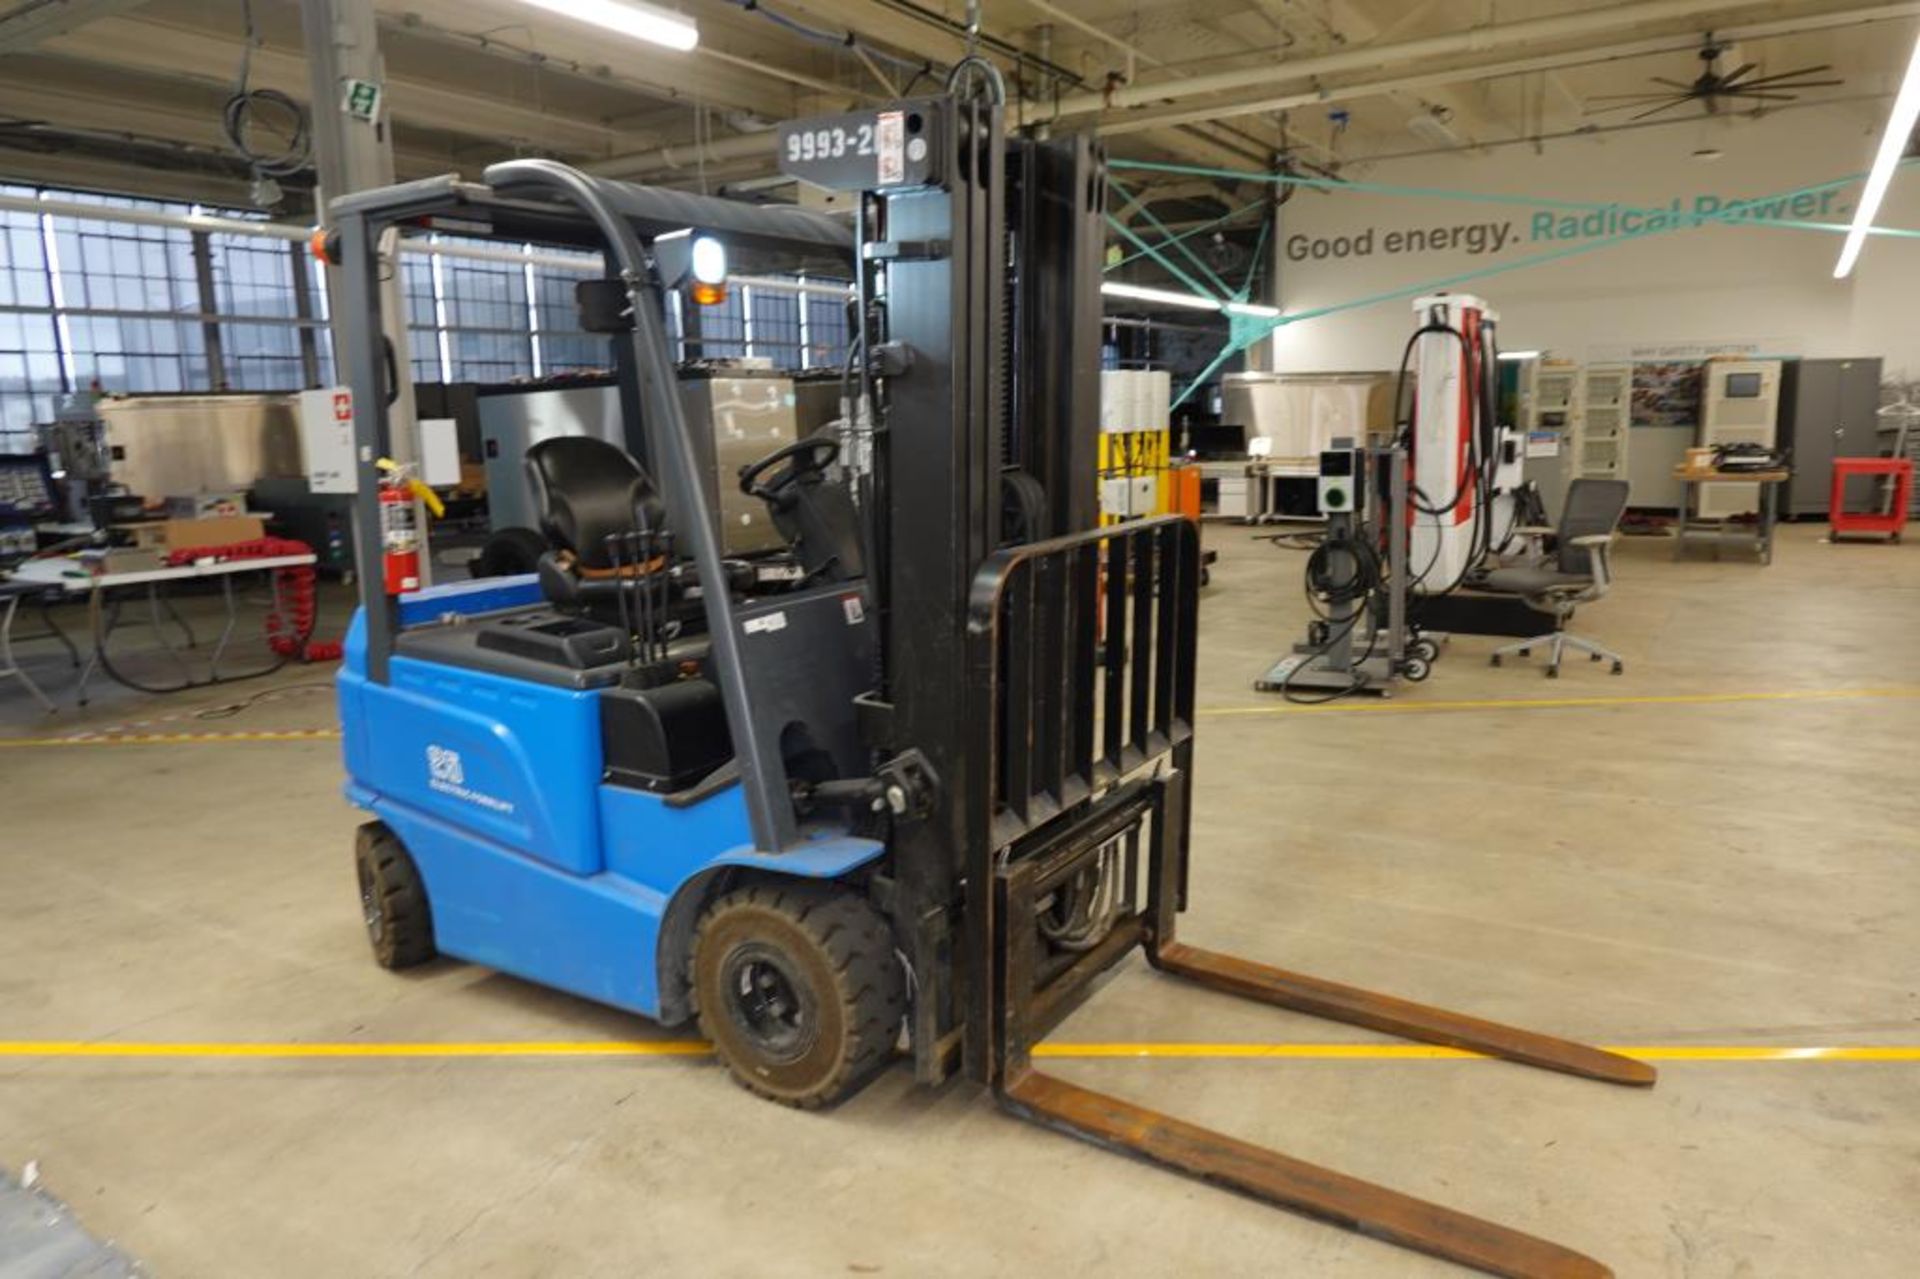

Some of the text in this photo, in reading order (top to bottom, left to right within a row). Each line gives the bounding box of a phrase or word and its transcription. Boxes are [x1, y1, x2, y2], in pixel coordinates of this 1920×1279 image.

[1286, 228, 1374, 261] Good
[1383, 222, 1520, 255] energy.
[1530, 198, 1680, 242] Radical
